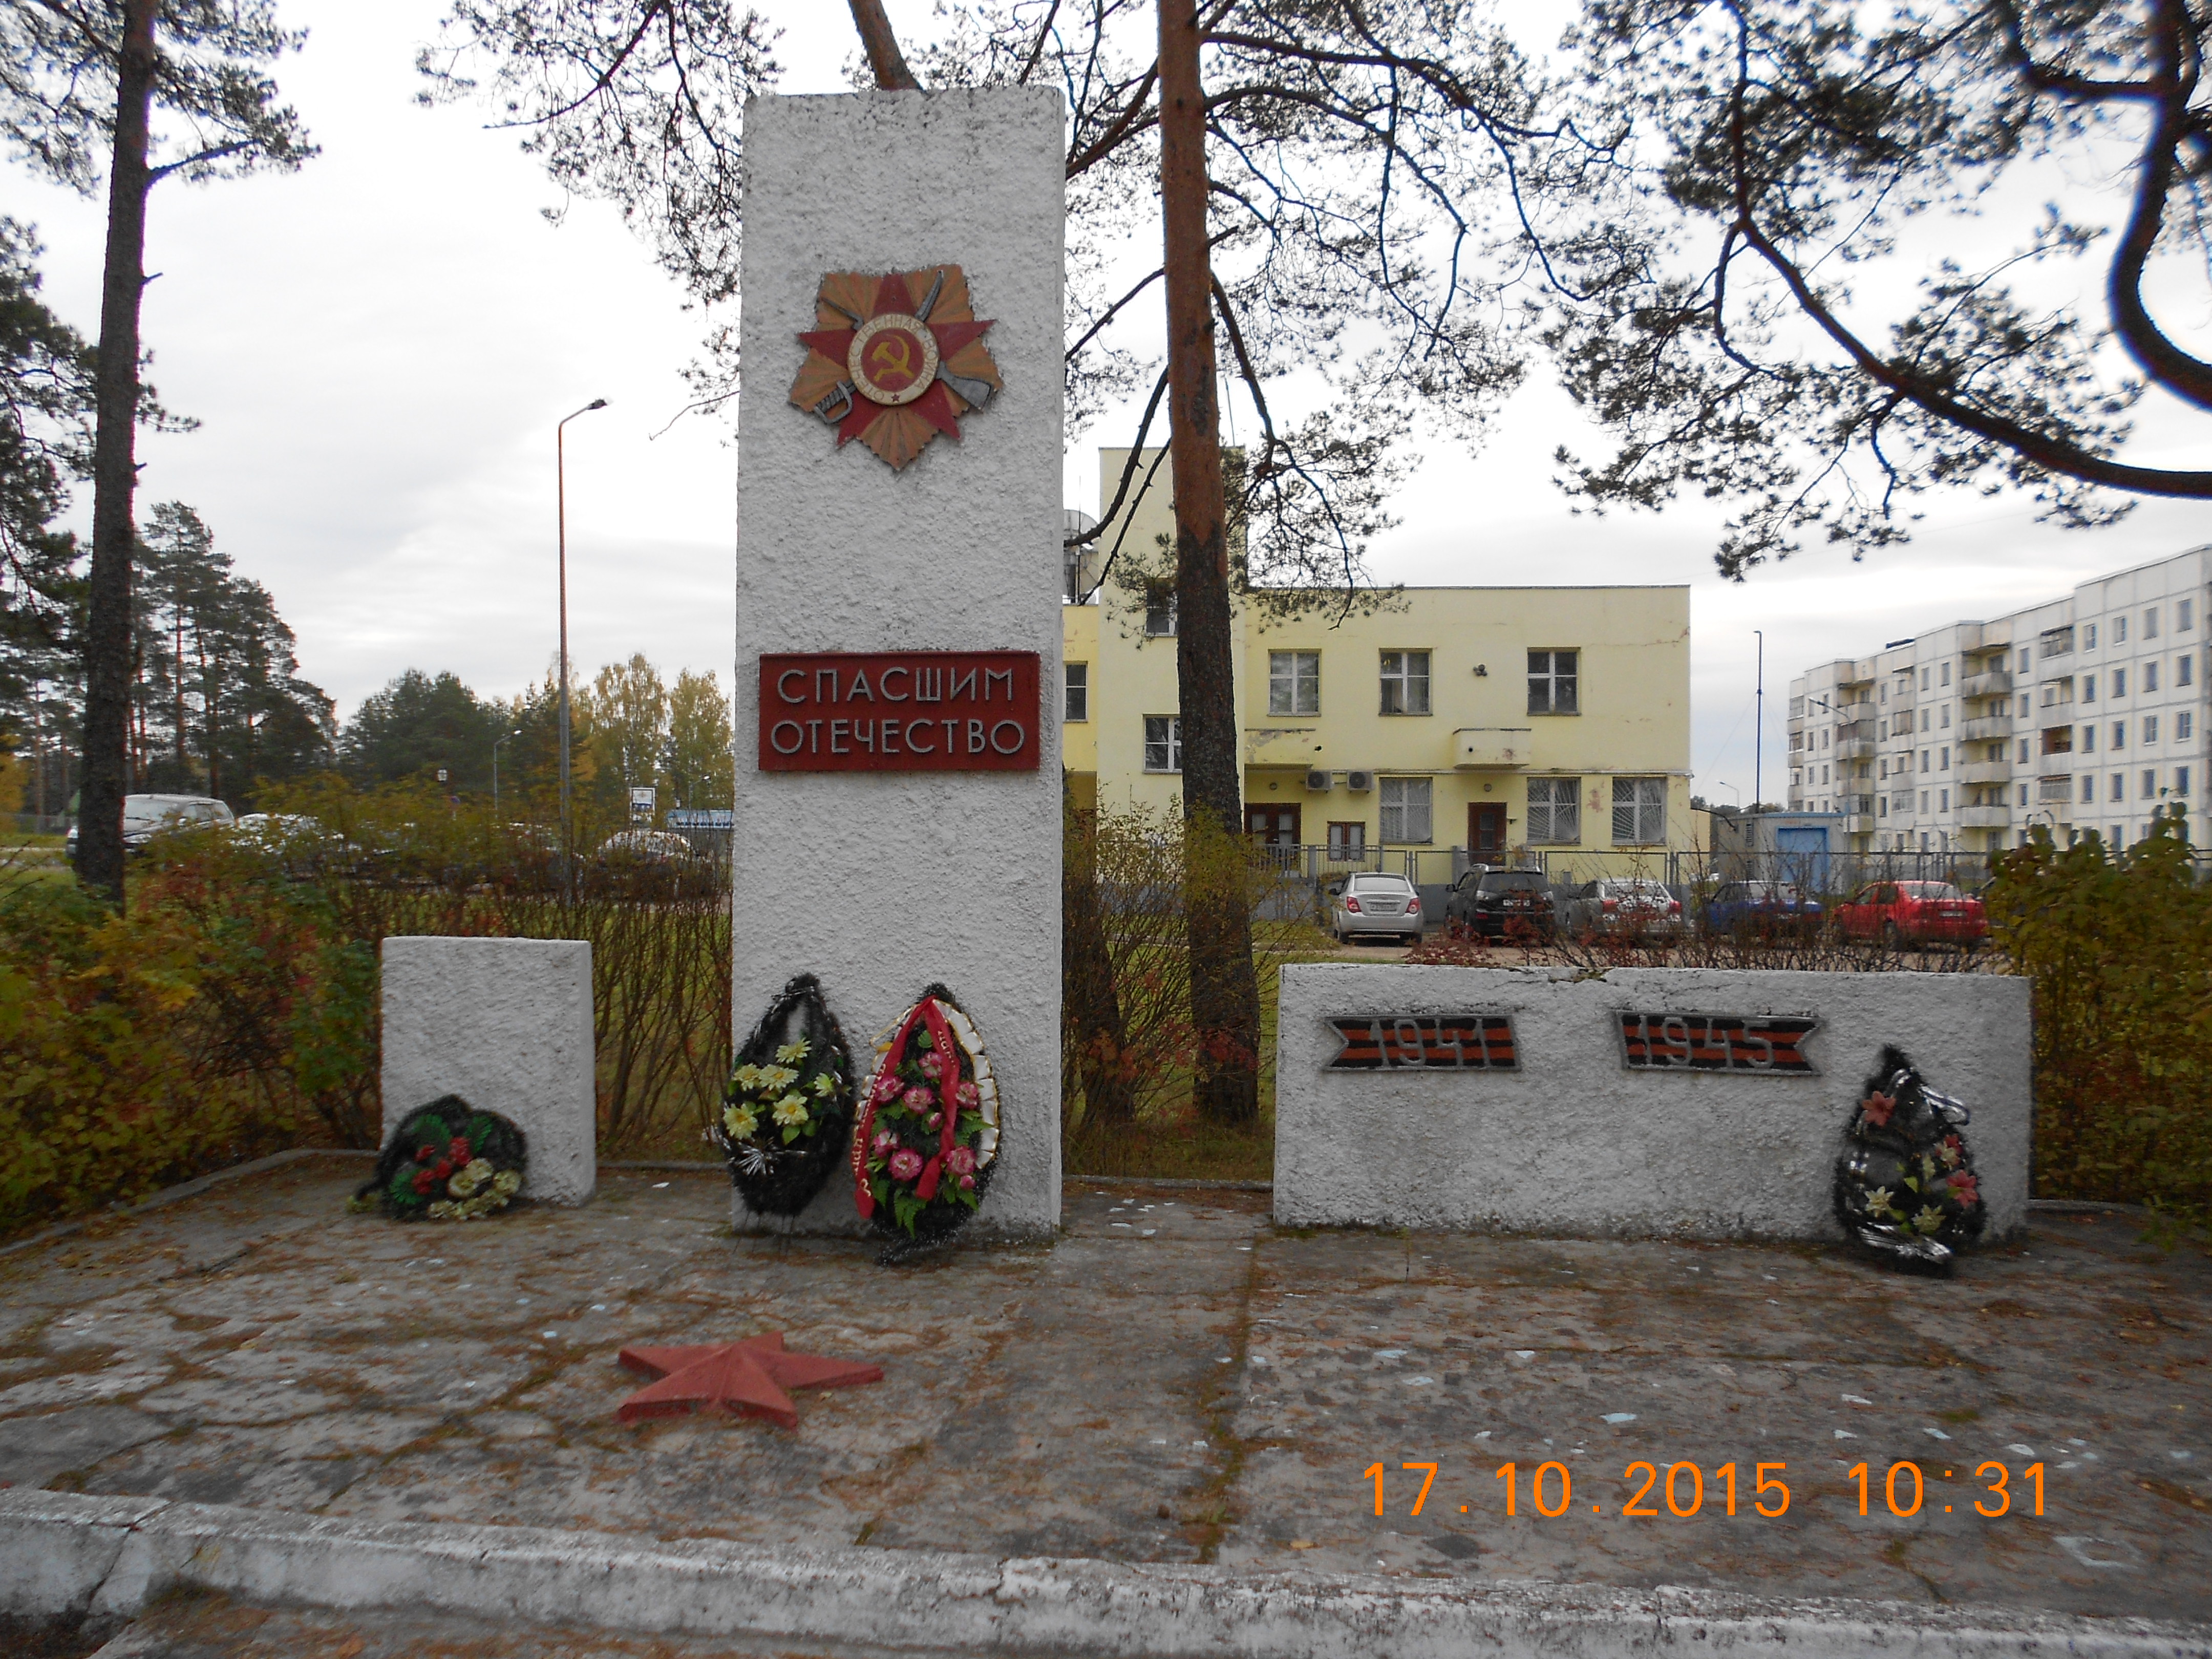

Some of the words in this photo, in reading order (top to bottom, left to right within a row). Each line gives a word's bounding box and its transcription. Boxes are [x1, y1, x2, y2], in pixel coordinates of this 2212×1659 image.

[777, 667, 1013, 704] СПАСШИМ
[771, 718, 1024, 755] ОТЕЧЕСТВО
[1369, 1018, 1492, 1067] 1941
[1639, 1015, 1774, 1069] 1945
